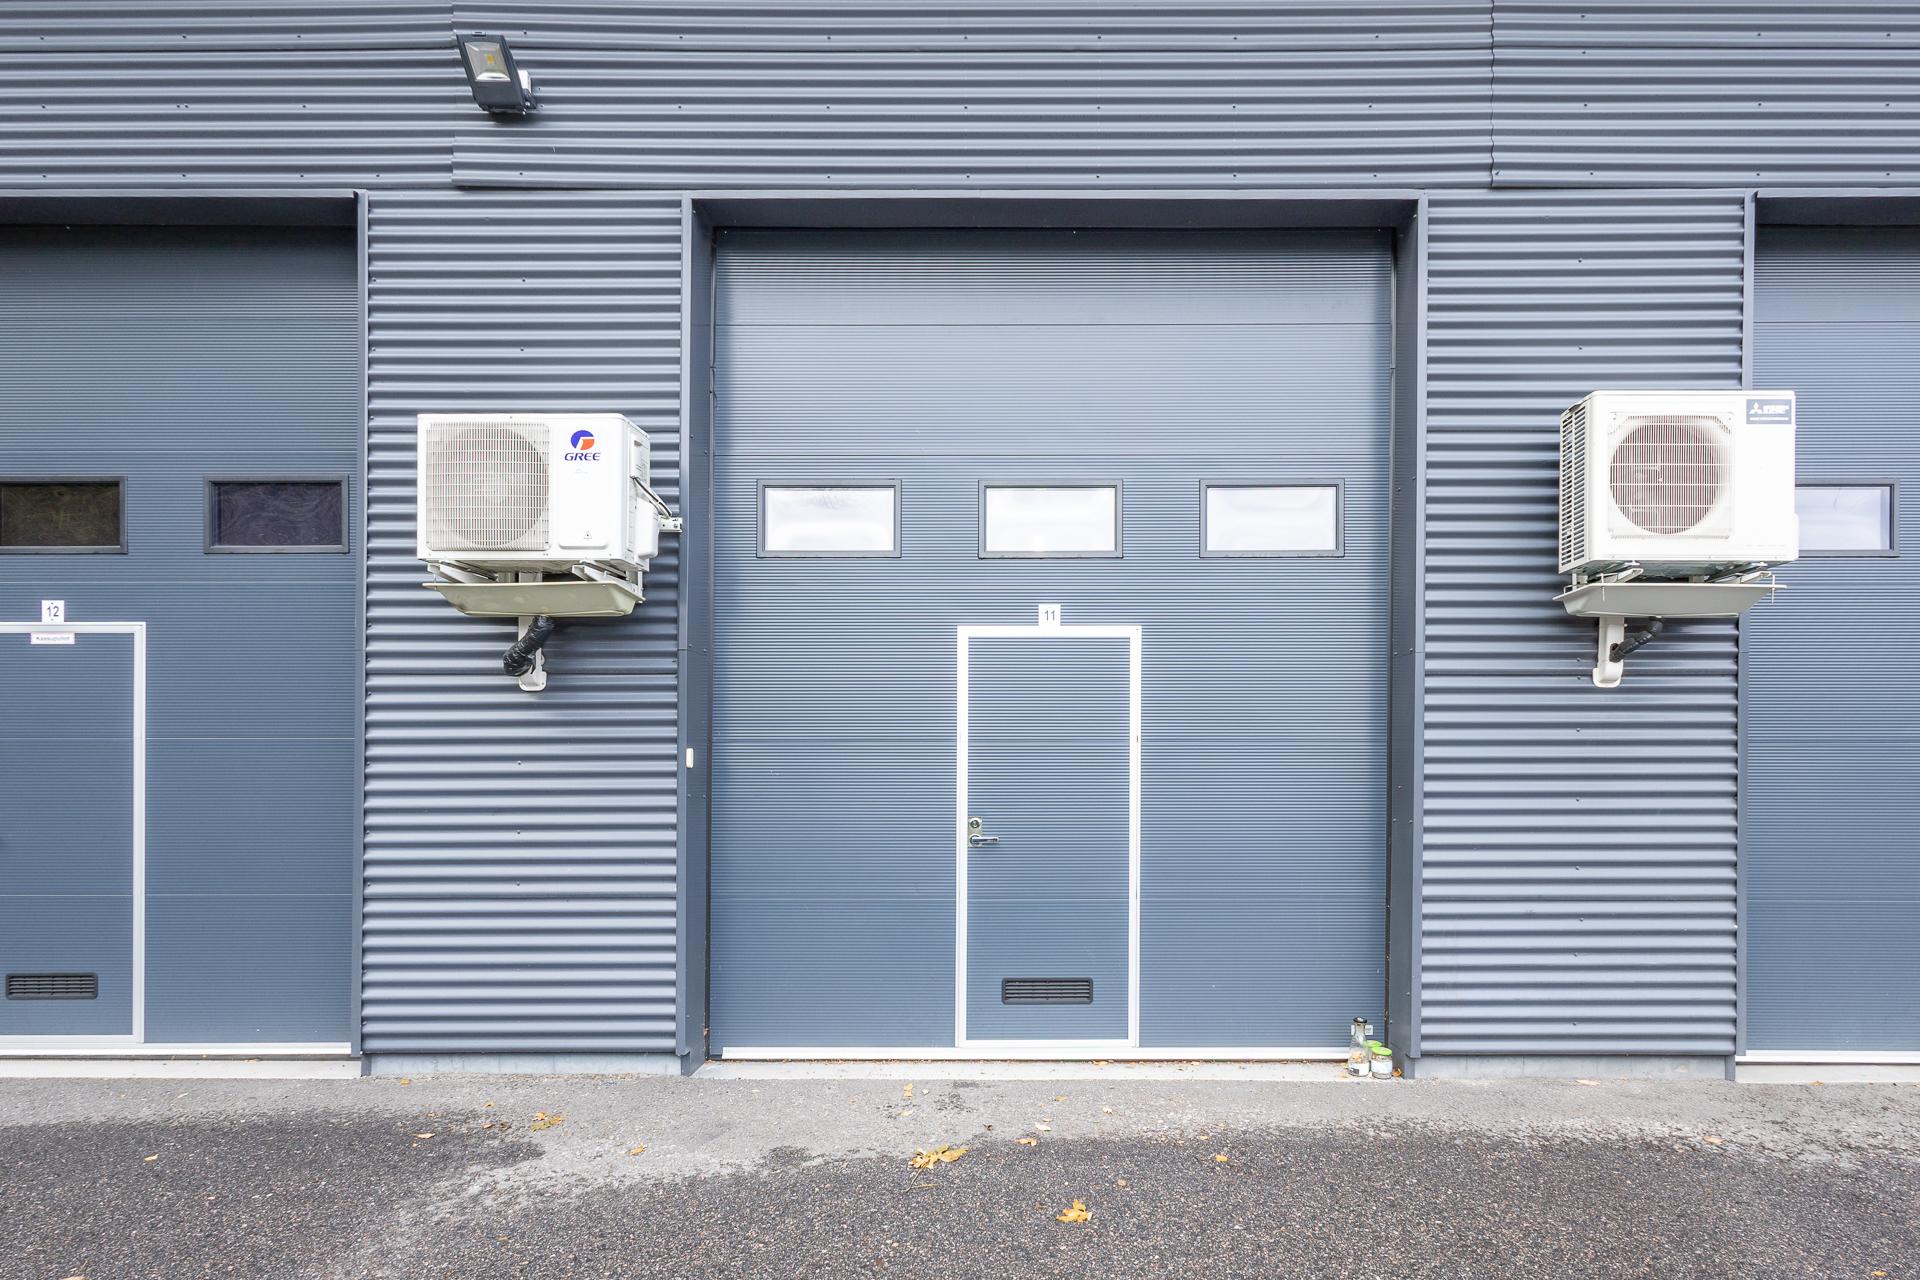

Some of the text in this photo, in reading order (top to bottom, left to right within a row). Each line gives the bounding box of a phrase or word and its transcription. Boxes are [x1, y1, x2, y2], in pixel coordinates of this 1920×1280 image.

[564, 452, 602, 462] GREE
[46, 605, 60, 618] 12
[1044, 609, 1056, 622] 11
